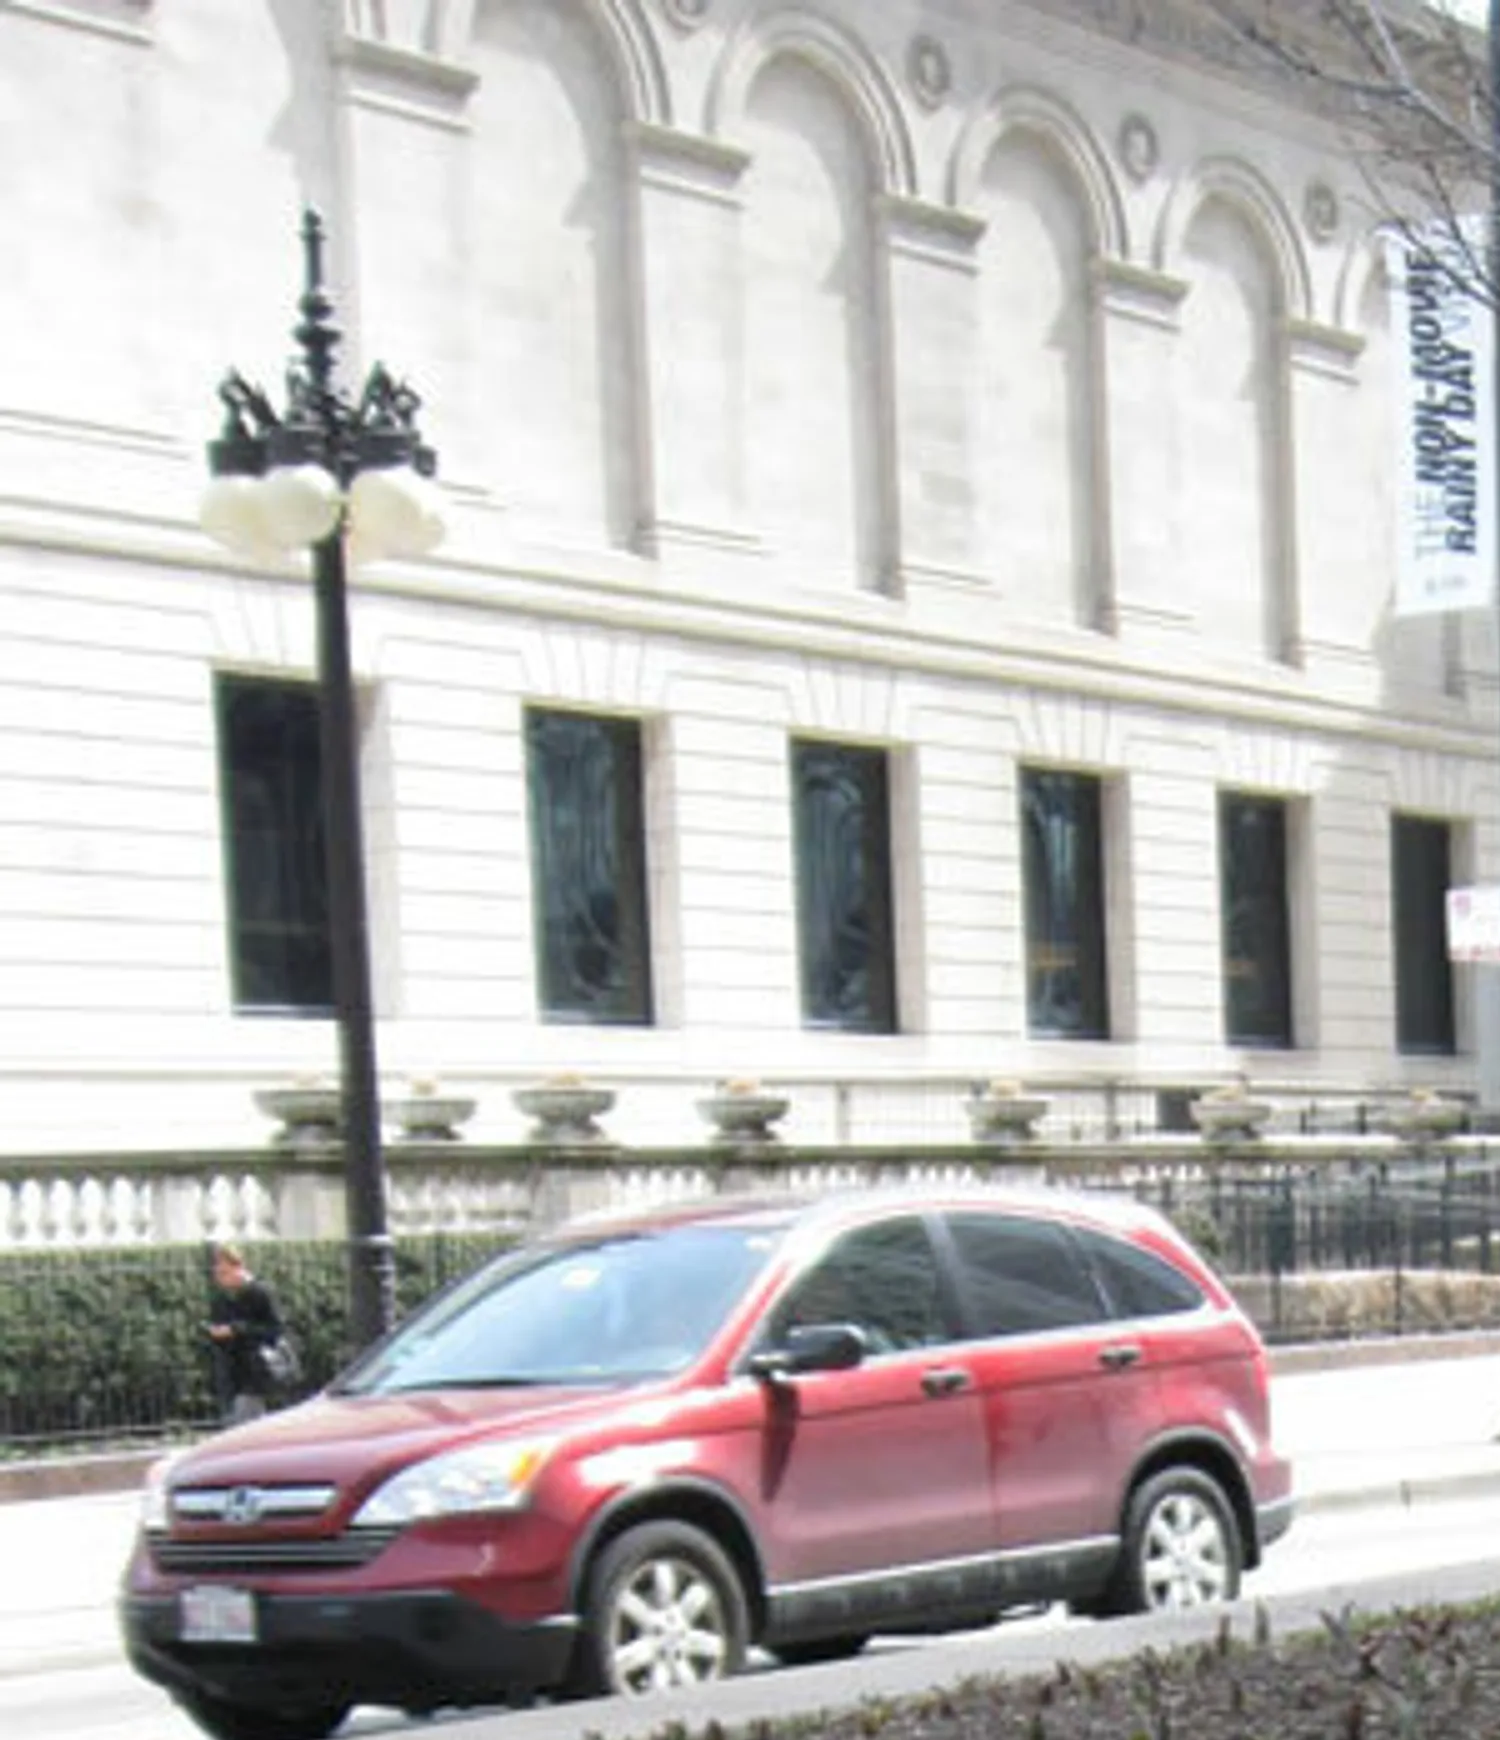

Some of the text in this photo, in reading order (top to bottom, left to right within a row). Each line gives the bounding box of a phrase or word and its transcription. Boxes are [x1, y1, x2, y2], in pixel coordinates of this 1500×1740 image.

[1406, 248, 1447, 560] THE NON-MOVIE
[1442, 341, 1477, 442] DAY
[1444, 431, 1477, 555] RAINY
